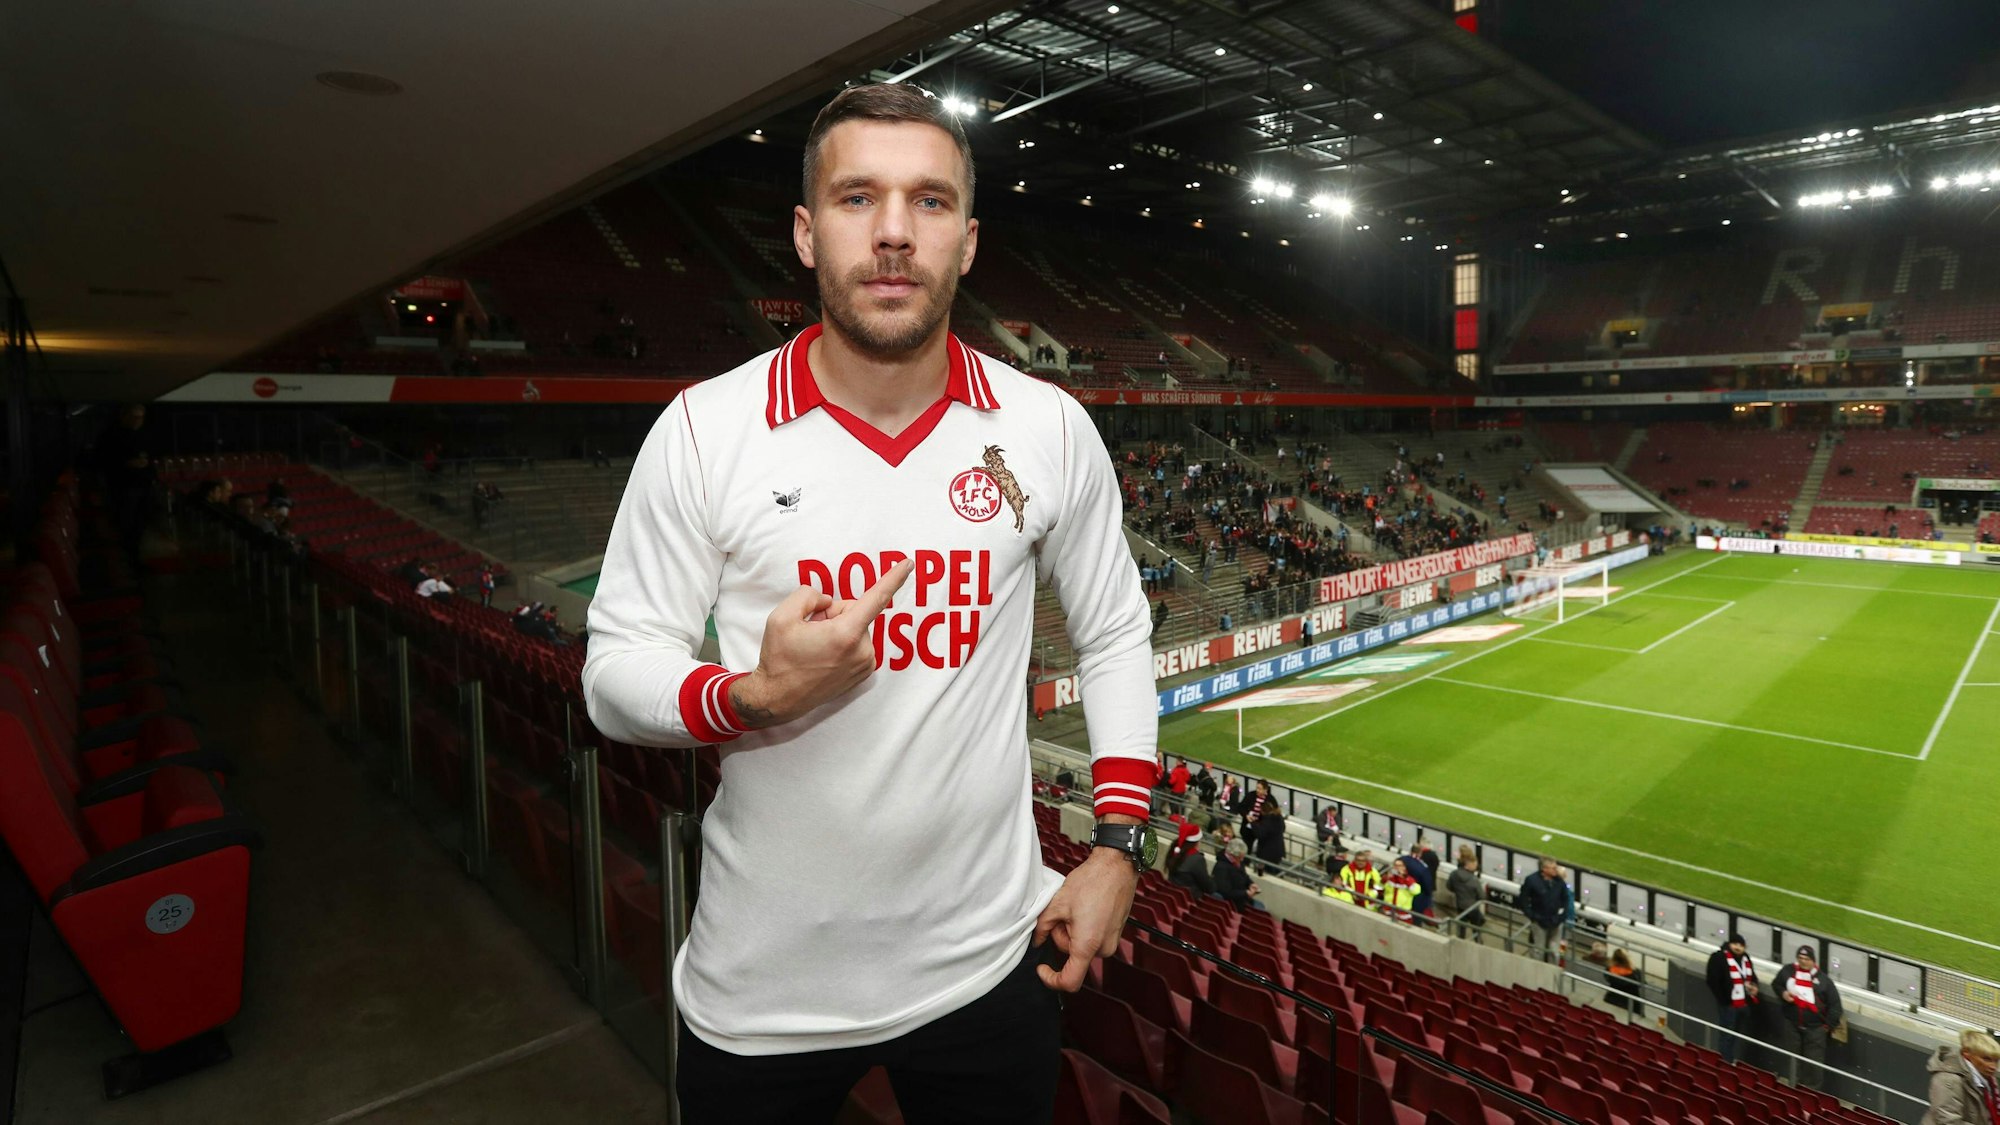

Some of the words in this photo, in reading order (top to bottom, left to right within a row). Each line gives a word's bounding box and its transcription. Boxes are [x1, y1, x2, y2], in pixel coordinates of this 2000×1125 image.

[752, 299, 803, 318] HAWKS
[1142, 392, 1160, 404] HANS
[1161, 390, 1190, 404] SCHÄFER
[1192, 391, 1222, 404] SÜDKURVE
[960, 487, 992, 504] 1.FC
[962, 504, 990, 517] KÖLN
[1774, 541, 1848, 557] ASSBRAUSE
[798, 550, 993, 609] DOPPEL
[1321, 566, 1384, 603] STANDORT
[1400, 582, 1433, 610] REWE
[870, 610, 981, 672] USCH
[1233, 623, 1282, 658] REWE
[1154, 641, 1210, 681] REWE
[1173, 683, 1204, 707] rial
[1212, 671, 1241, 694] rial
[1248, 661, 1274, 682] rial
[1281, 652, 1305, 673] rial
[1311, 643, 1332, 662] rial
[1338, 634, 1359, 654] rial
[1364, 628, 1384, 646] rial
[1389, 621, 1408, 638] rial
[158, 905, 182, 922] 25
